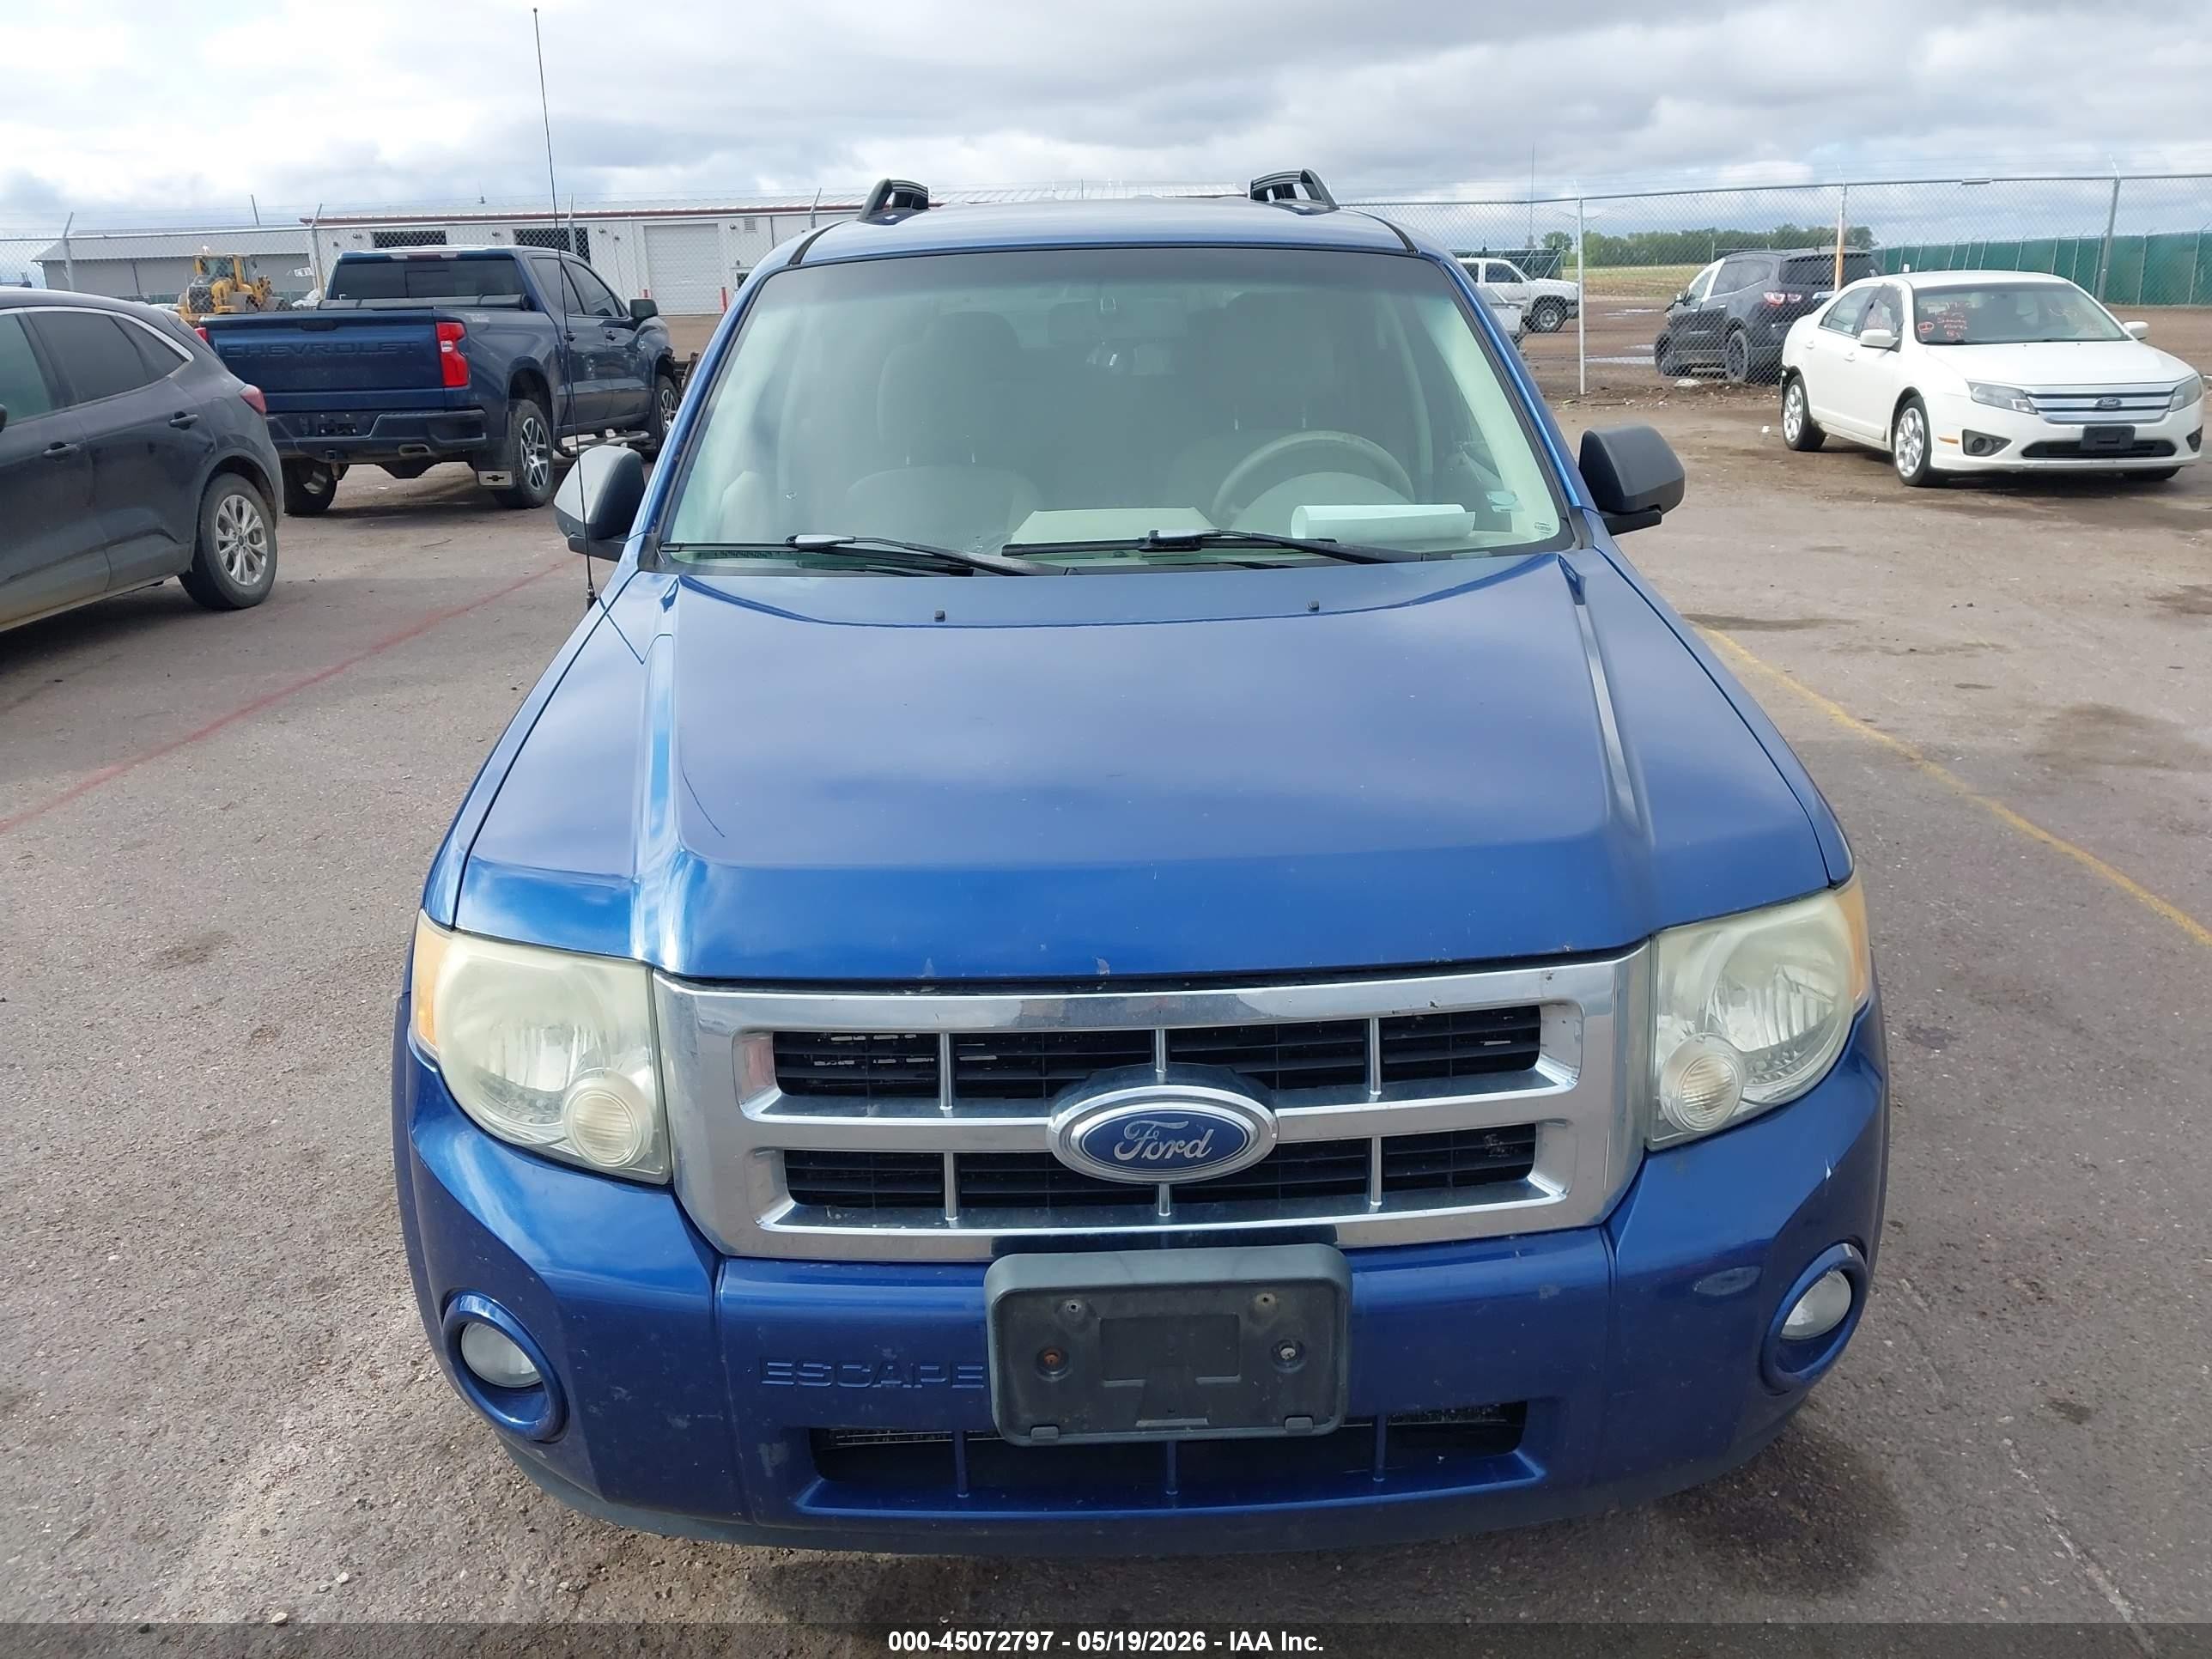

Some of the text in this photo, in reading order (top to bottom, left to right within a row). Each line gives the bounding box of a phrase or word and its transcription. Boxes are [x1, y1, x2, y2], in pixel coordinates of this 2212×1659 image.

[222, 341, 421, 358] CHEVROLET
[1113, 1120, 1215, 1161] Ford
[760, 1359, 985, 1389] ESCAPE
